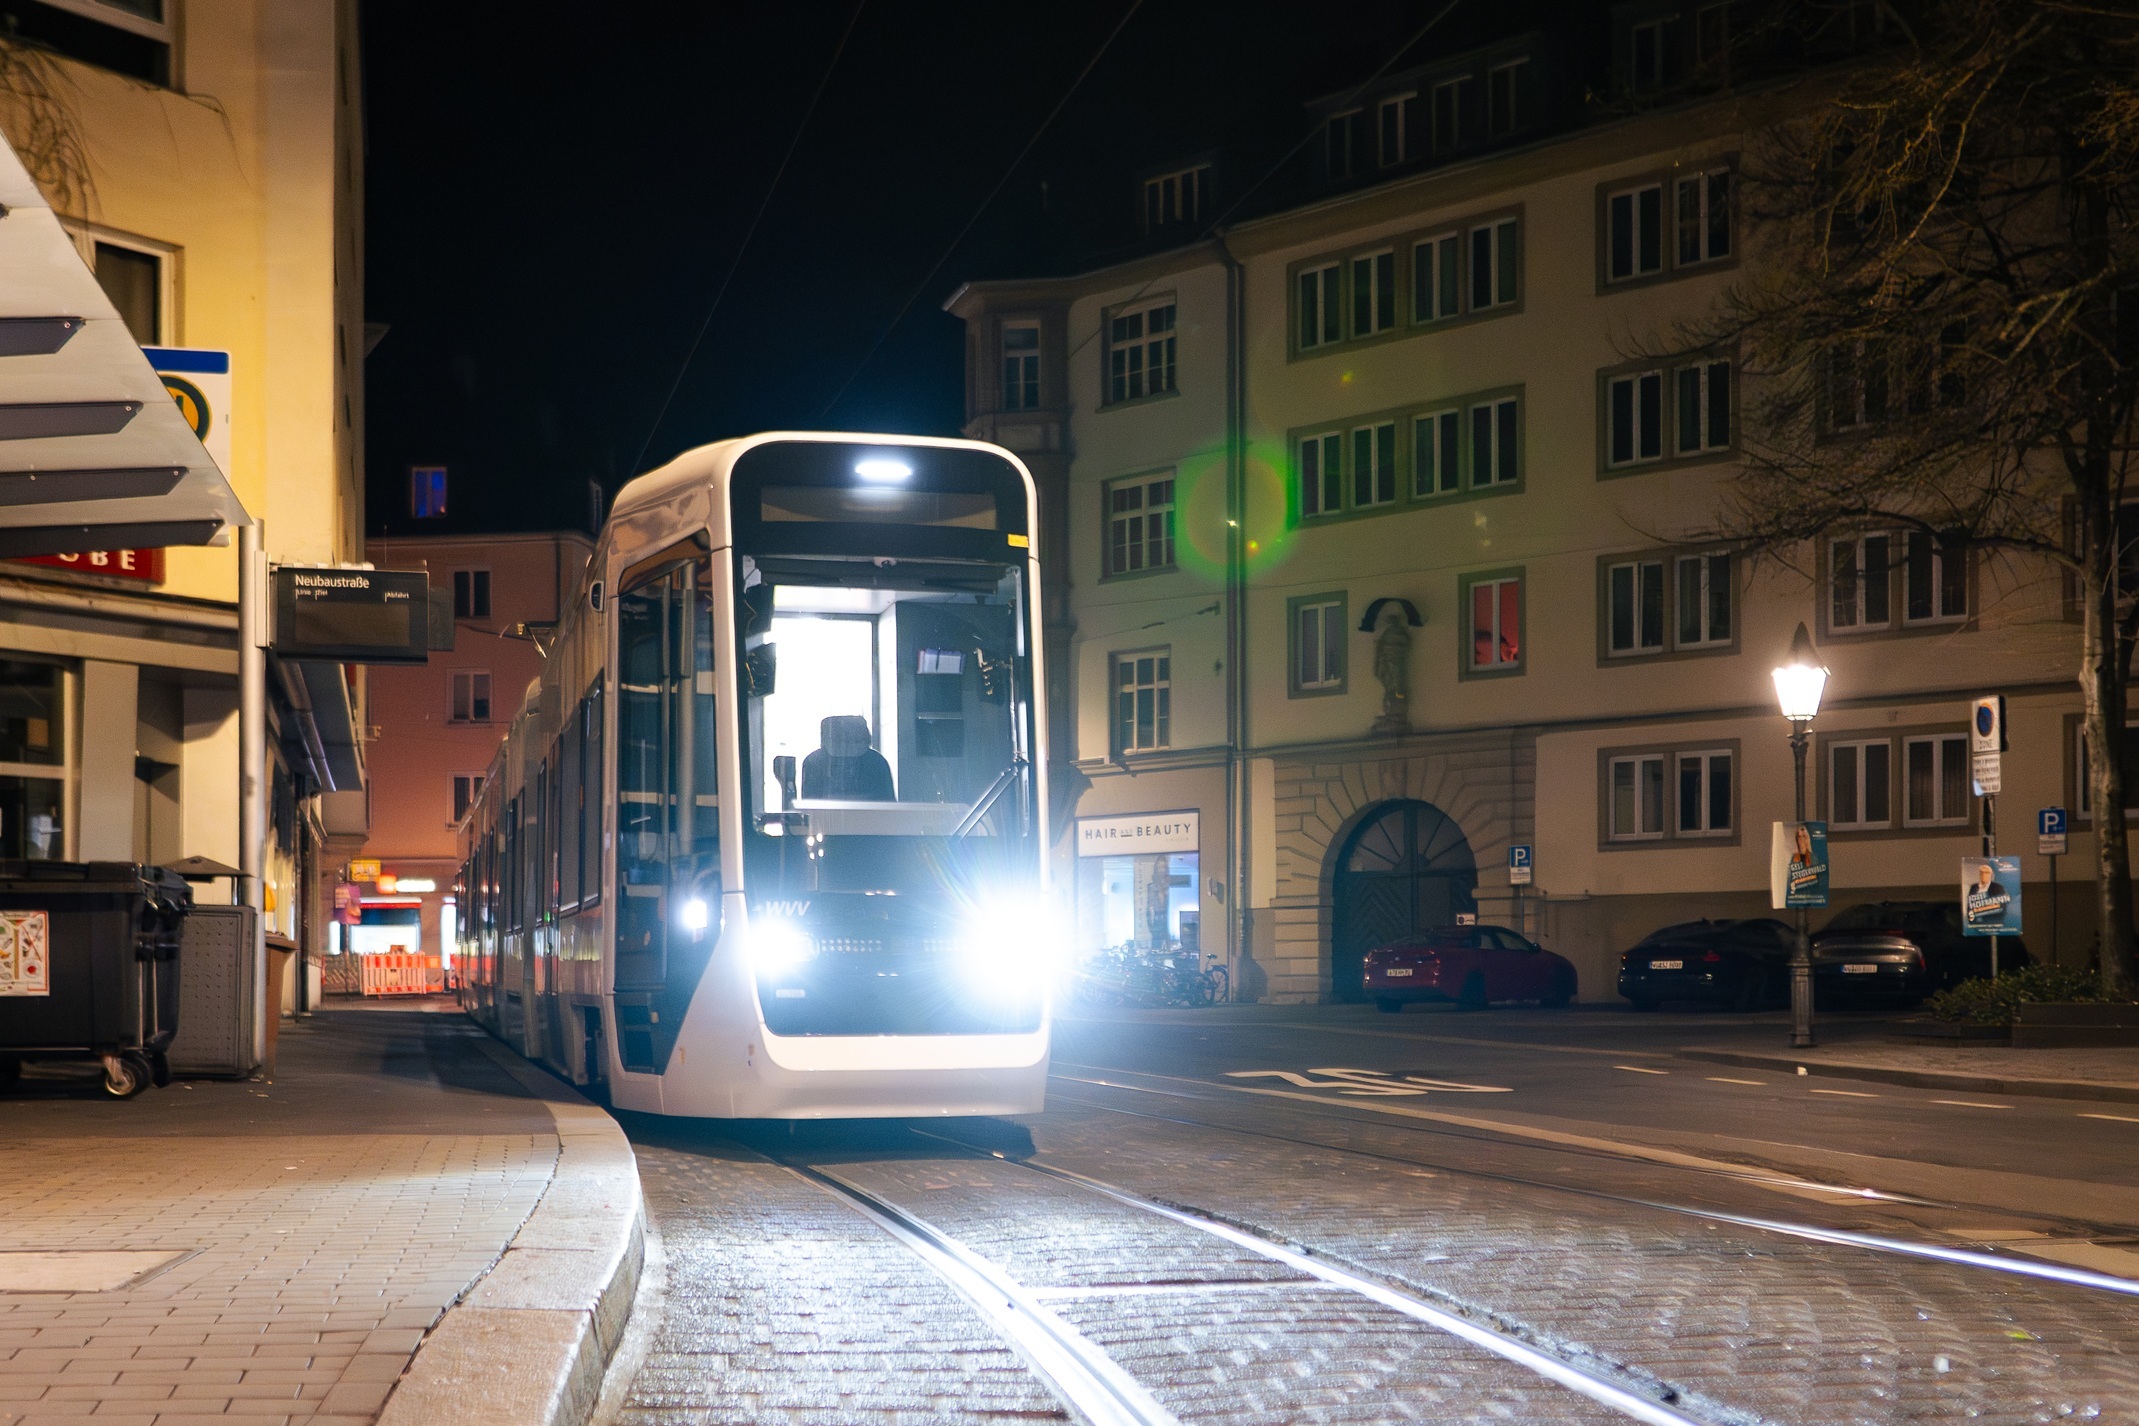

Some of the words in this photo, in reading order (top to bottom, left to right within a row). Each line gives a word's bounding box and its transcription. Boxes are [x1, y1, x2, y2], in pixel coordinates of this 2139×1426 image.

[295, 574, 370, 588] Neubaustraße
[1085, 828, 1118, 840] HAIR
[1136, 823, 1191, 837] BEAUTY
[766, 900, 811, 917] WVV
